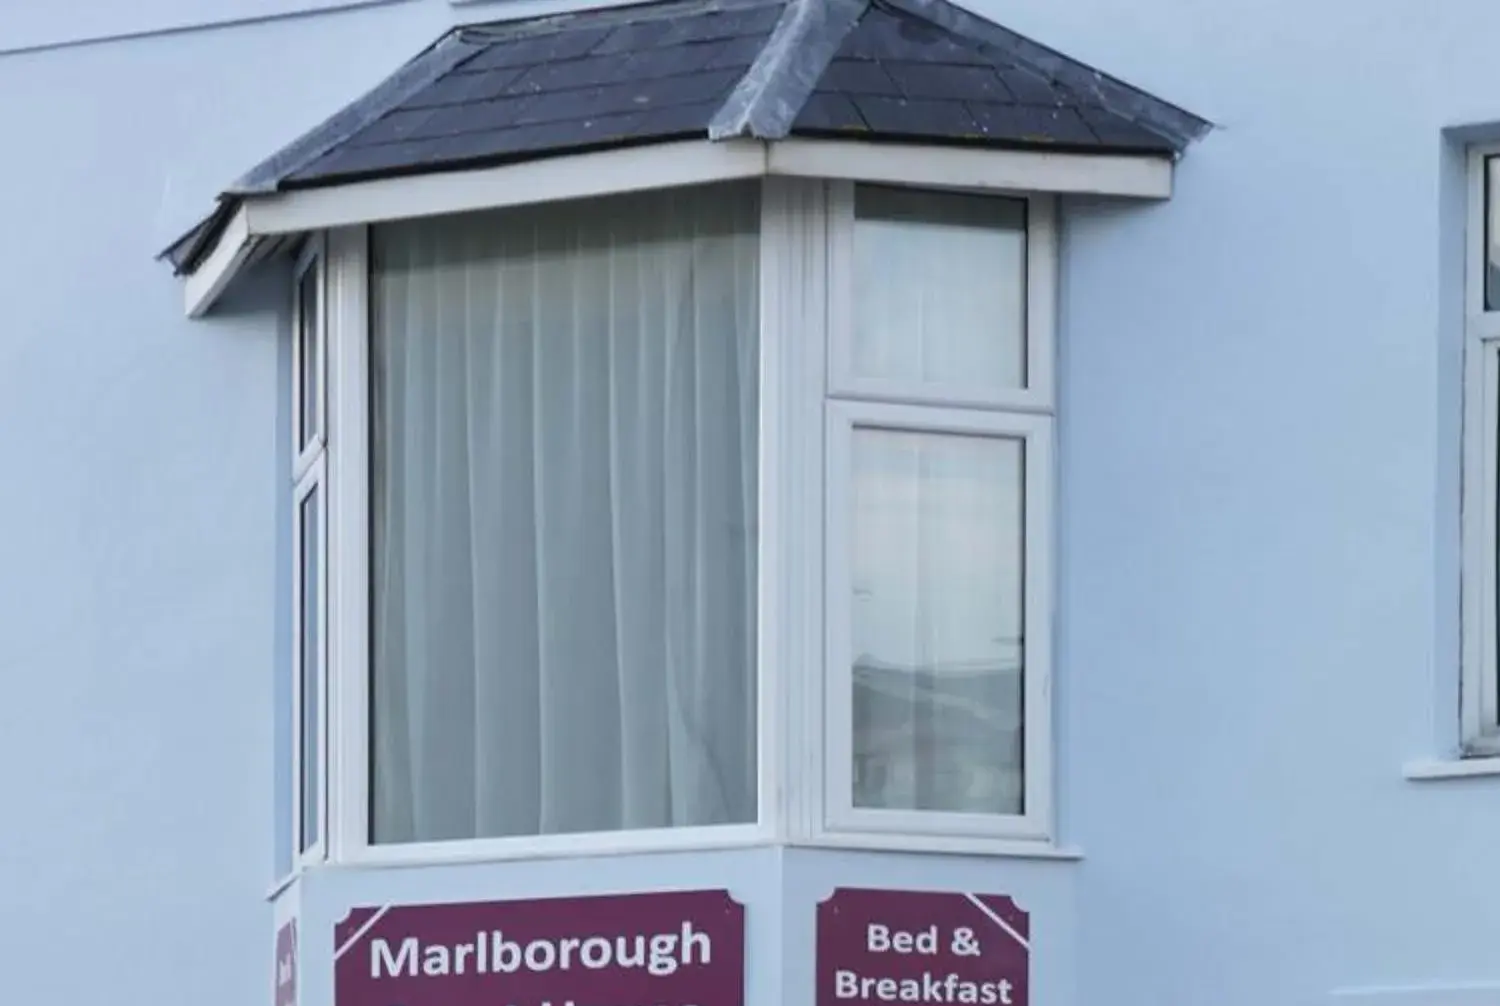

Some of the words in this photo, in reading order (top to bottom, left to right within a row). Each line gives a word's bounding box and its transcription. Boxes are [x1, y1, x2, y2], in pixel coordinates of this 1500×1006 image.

[370, 920, 712, 979] Marlborough
[867, 923, 938, 955] Bed
[951, 926, 981, 957] &
[834, 969, 1013, 1005] Breakfast
